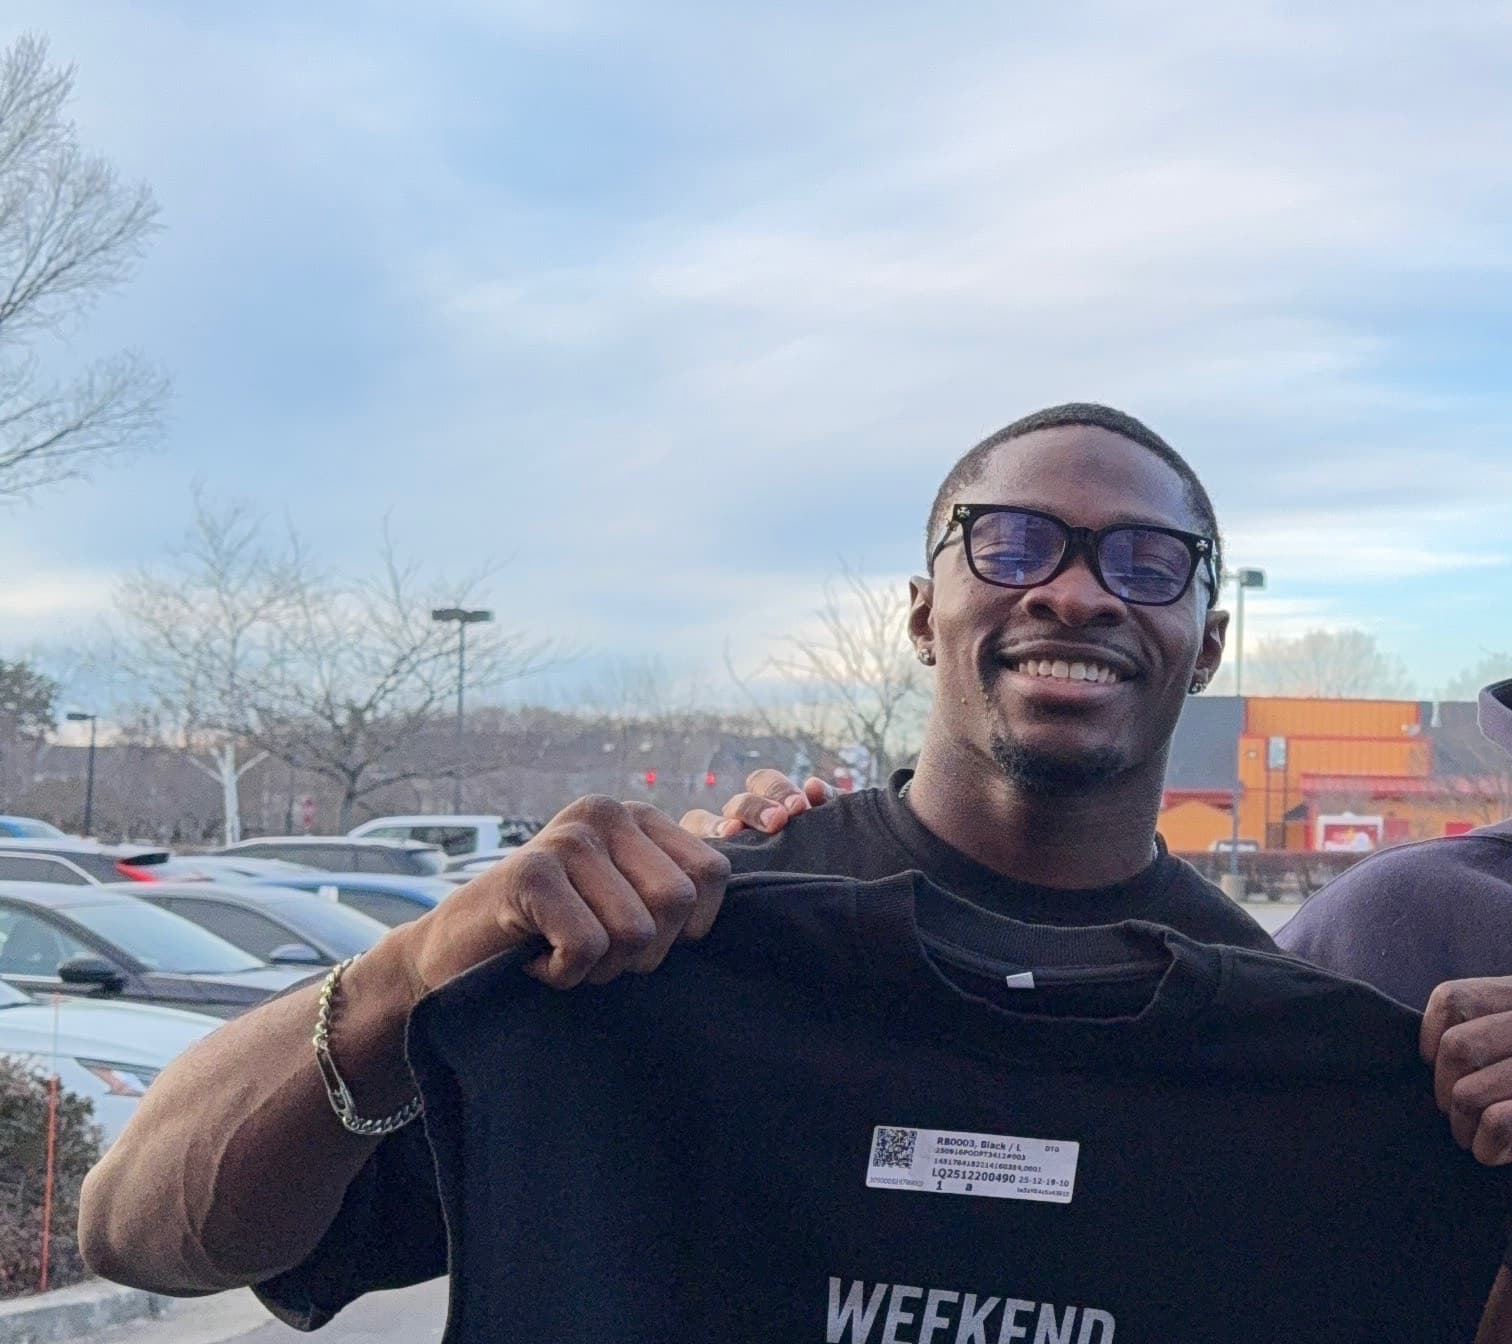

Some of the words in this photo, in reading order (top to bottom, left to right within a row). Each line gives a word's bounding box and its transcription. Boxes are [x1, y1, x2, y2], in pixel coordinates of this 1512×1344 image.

[981, 1140, 1006, 1150] Black
[932, 1167, 1016, 1185] LQ2512200490
[936, 1180, 943, 1191] 1
